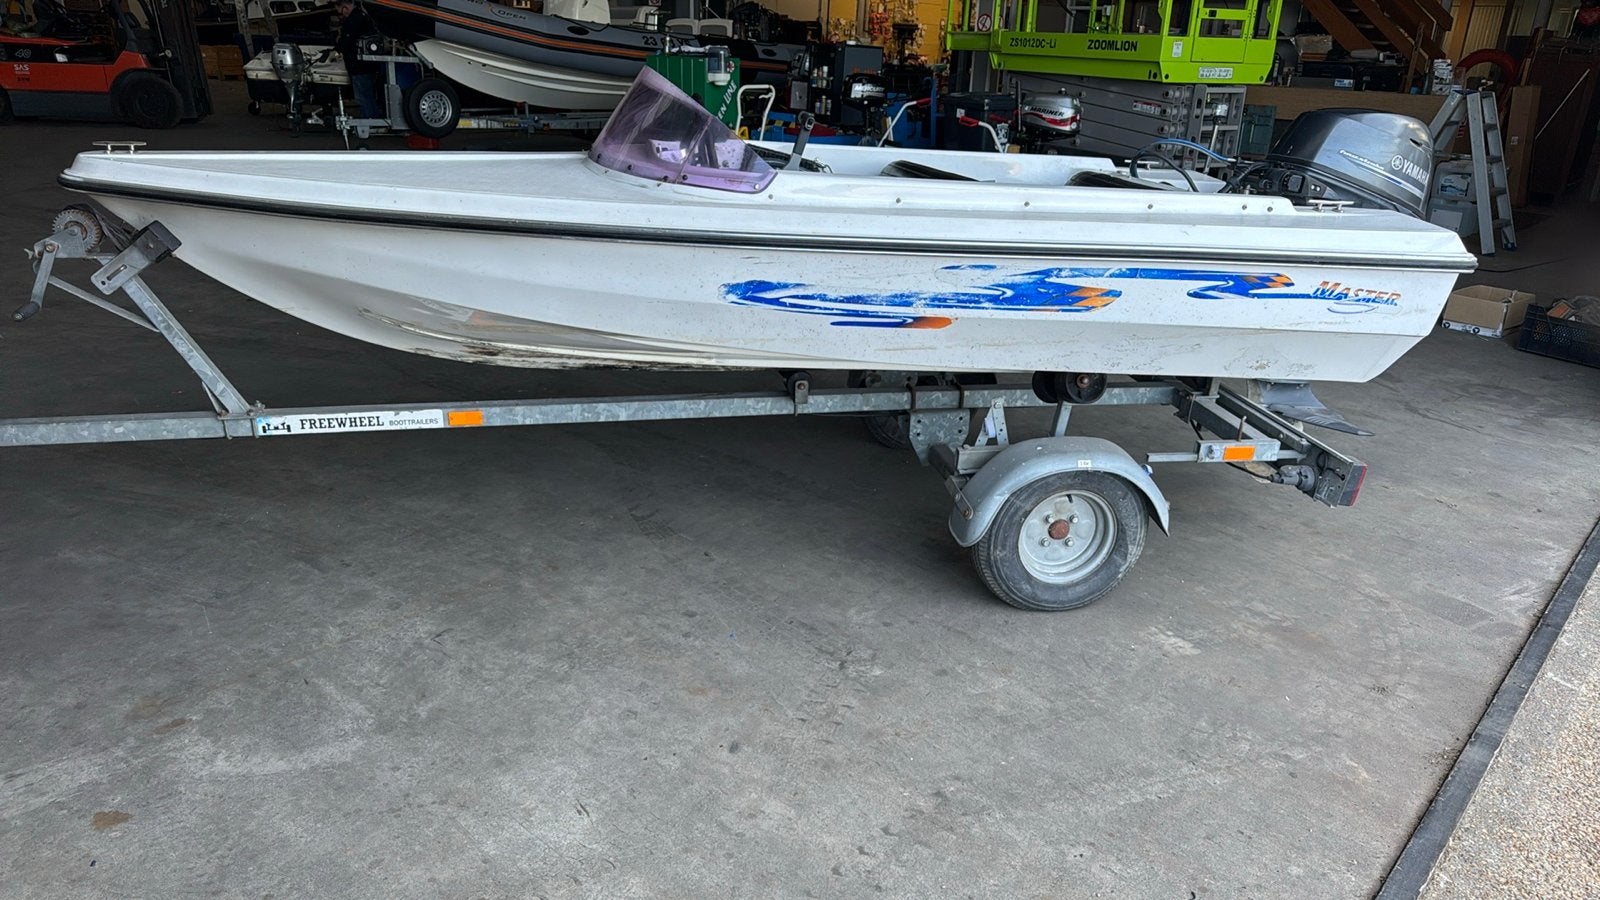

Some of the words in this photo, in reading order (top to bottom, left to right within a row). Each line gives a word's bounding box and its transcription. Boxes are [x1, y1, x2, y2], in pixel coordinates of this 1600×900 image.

[1009, 37, 1057, 49] ZS1012DC-Li
[1087, 39, 1138, 52] ZOOMLION
[1030, 106, 1065, 117] MARINER
[1312, 280, 1402, 306] MASTER
[299, 415, 385, 430] FREEWHEEL
[389, 417, 439, 427] BOOTTRAILERS
